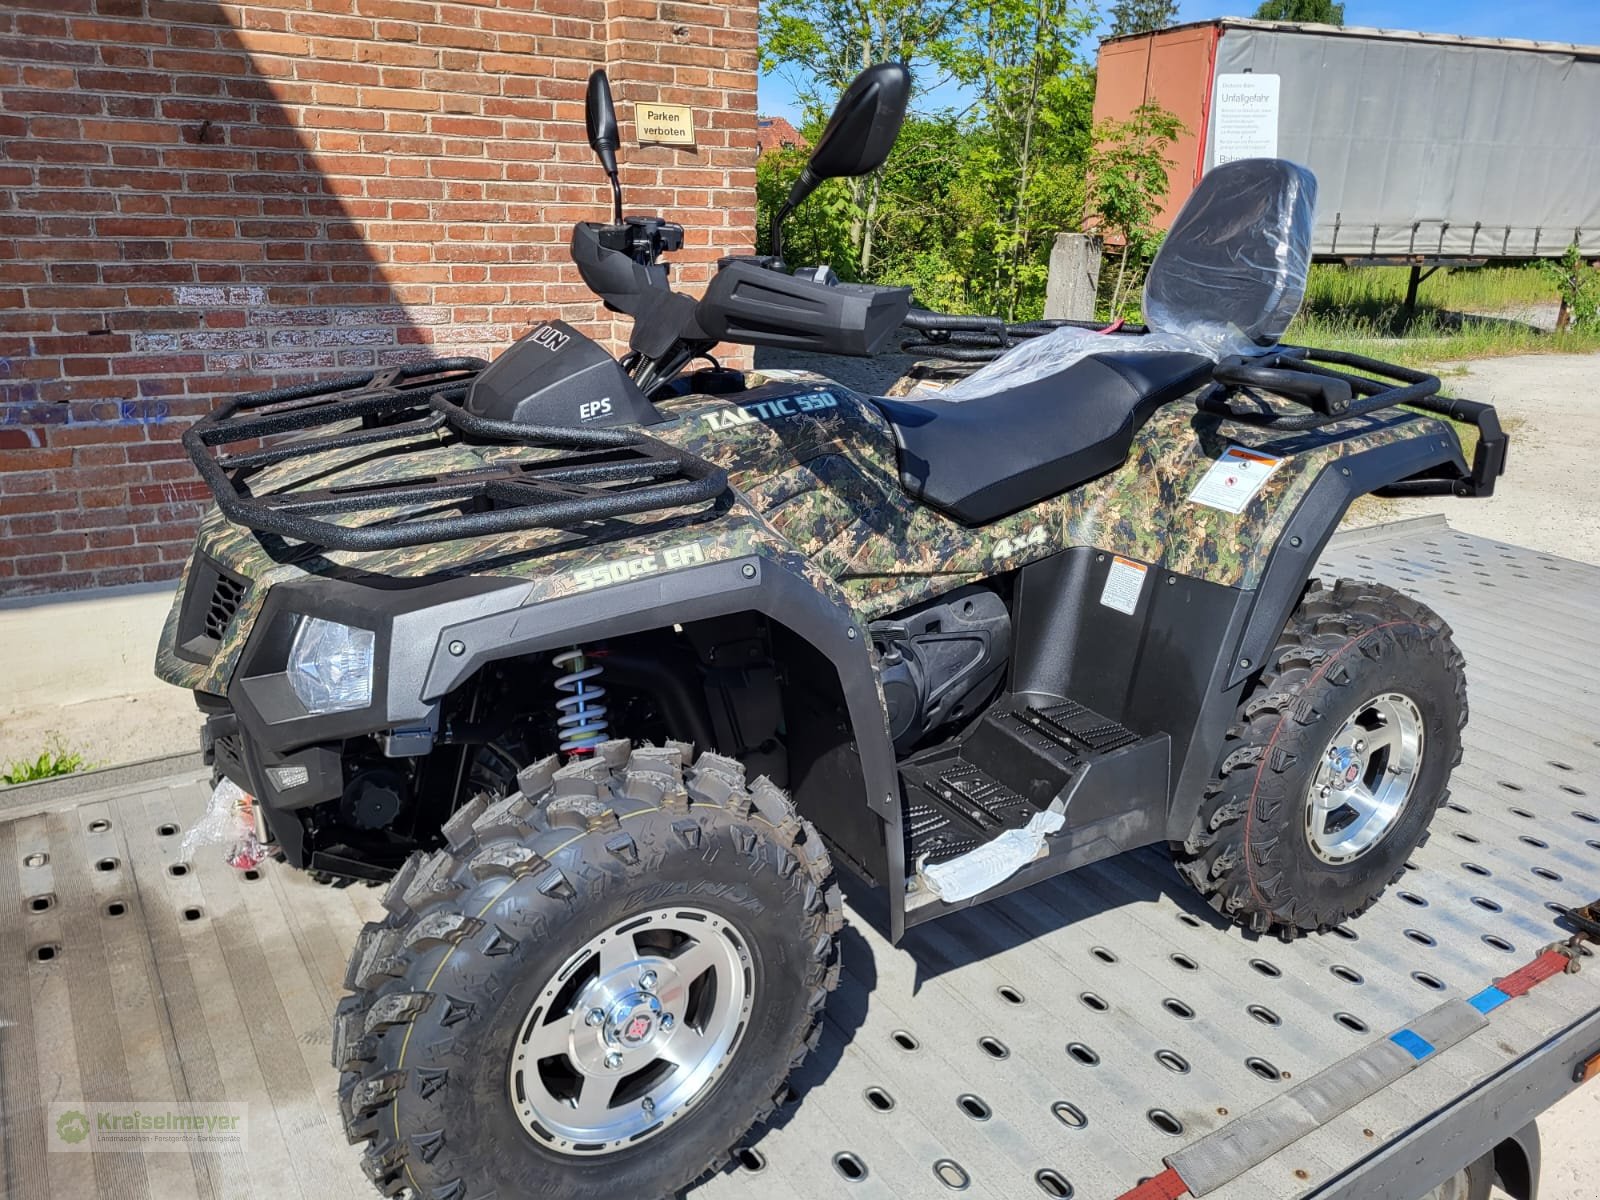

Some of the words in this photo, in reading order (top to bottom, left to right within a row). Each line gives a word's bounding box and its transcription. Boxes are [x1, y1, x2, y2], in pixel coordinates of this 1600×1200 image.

[647, 110, 680, 121] Parken
[643, 126, 686, 137] verboten
[579, 397, 612, 420] EPS
[701, 397, 797, 432] TACTIC
[797, 391, 838, 413] 550
[992, 525, 1048, 559] 4x4
[573, 555, 658, 591] 550cc
[662, 542, 705, 569] EFI
